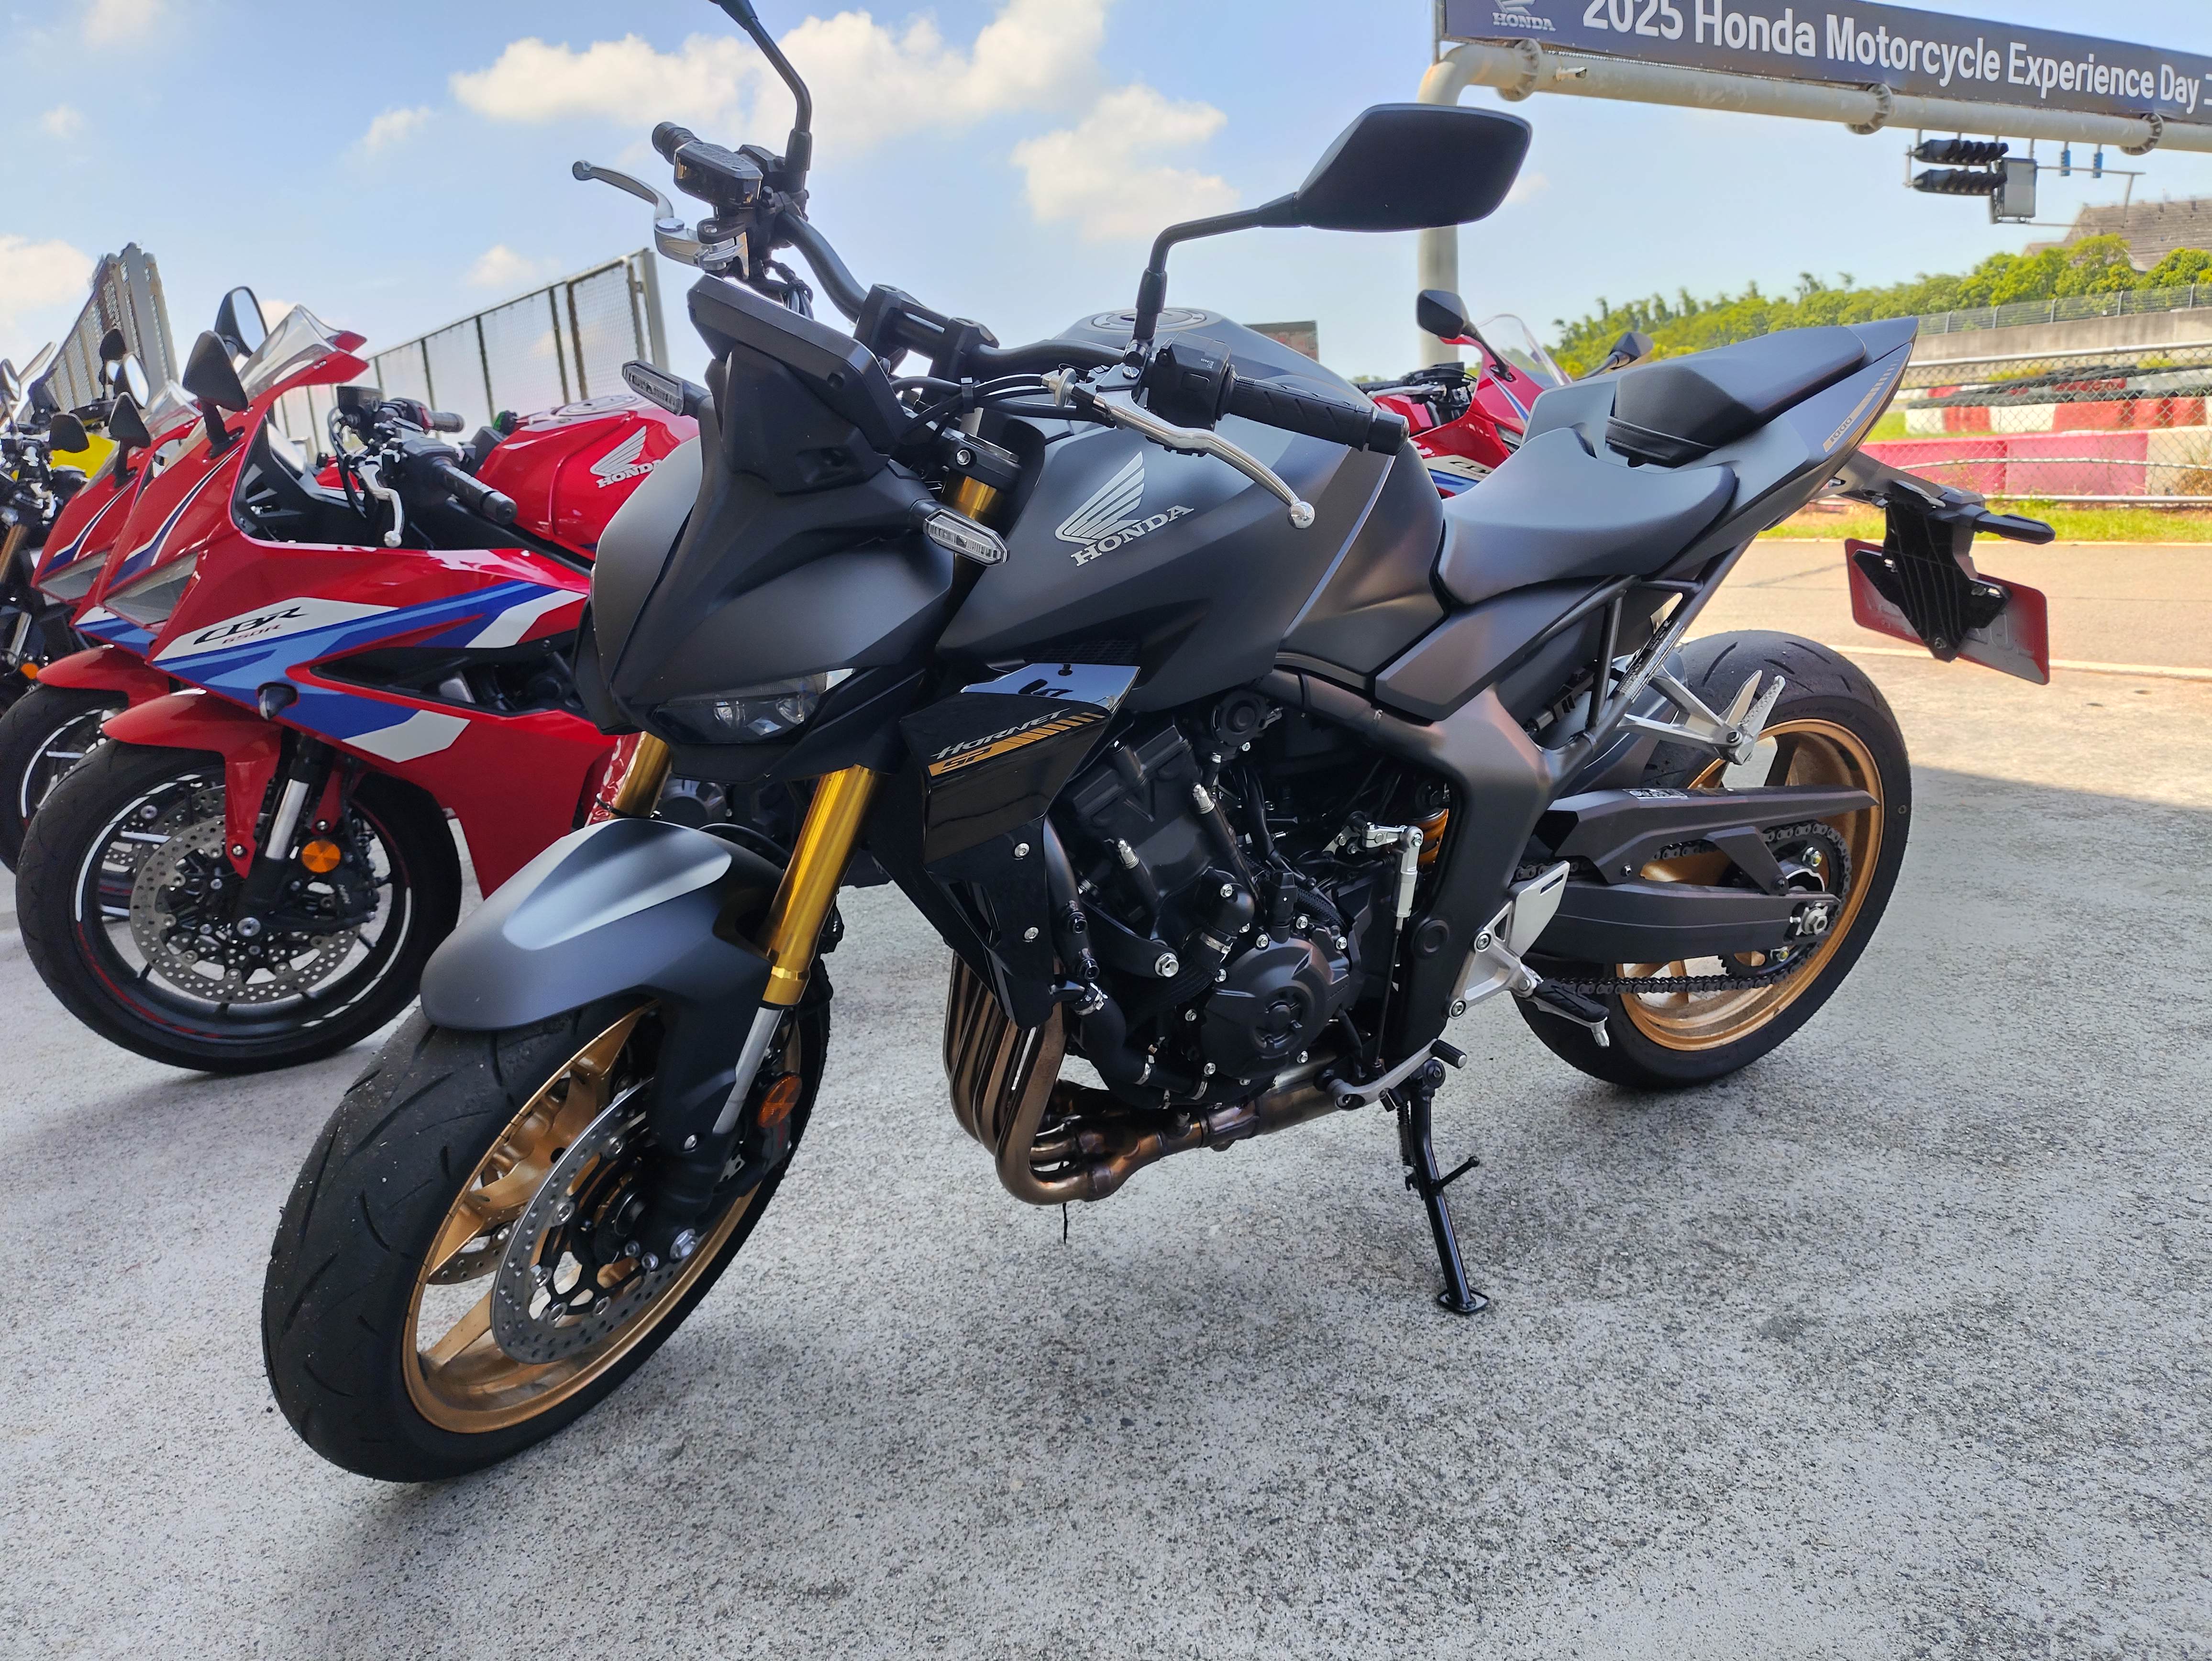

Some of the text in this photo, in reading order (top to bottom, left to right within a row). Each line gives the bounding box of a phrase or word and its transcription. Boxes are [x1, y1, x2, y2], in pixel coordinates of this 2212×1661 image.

[1492, 12, 1557, 32] HONDA
[1583, 0, 1683, 40] 2025
[1695, 0, 1816, 57] Honda
[1825, 13, 2001, 88] Motorcycle
[2007, 42, 2155, 99] Experience
[2160, 63, 2200, 114] Day
[1449, 461, 1493, 474] CB
[1070, 505, 1195, 567] HONDA
[193, 606, 310, 645] CBR
[941, 746, 993, 770] SP
